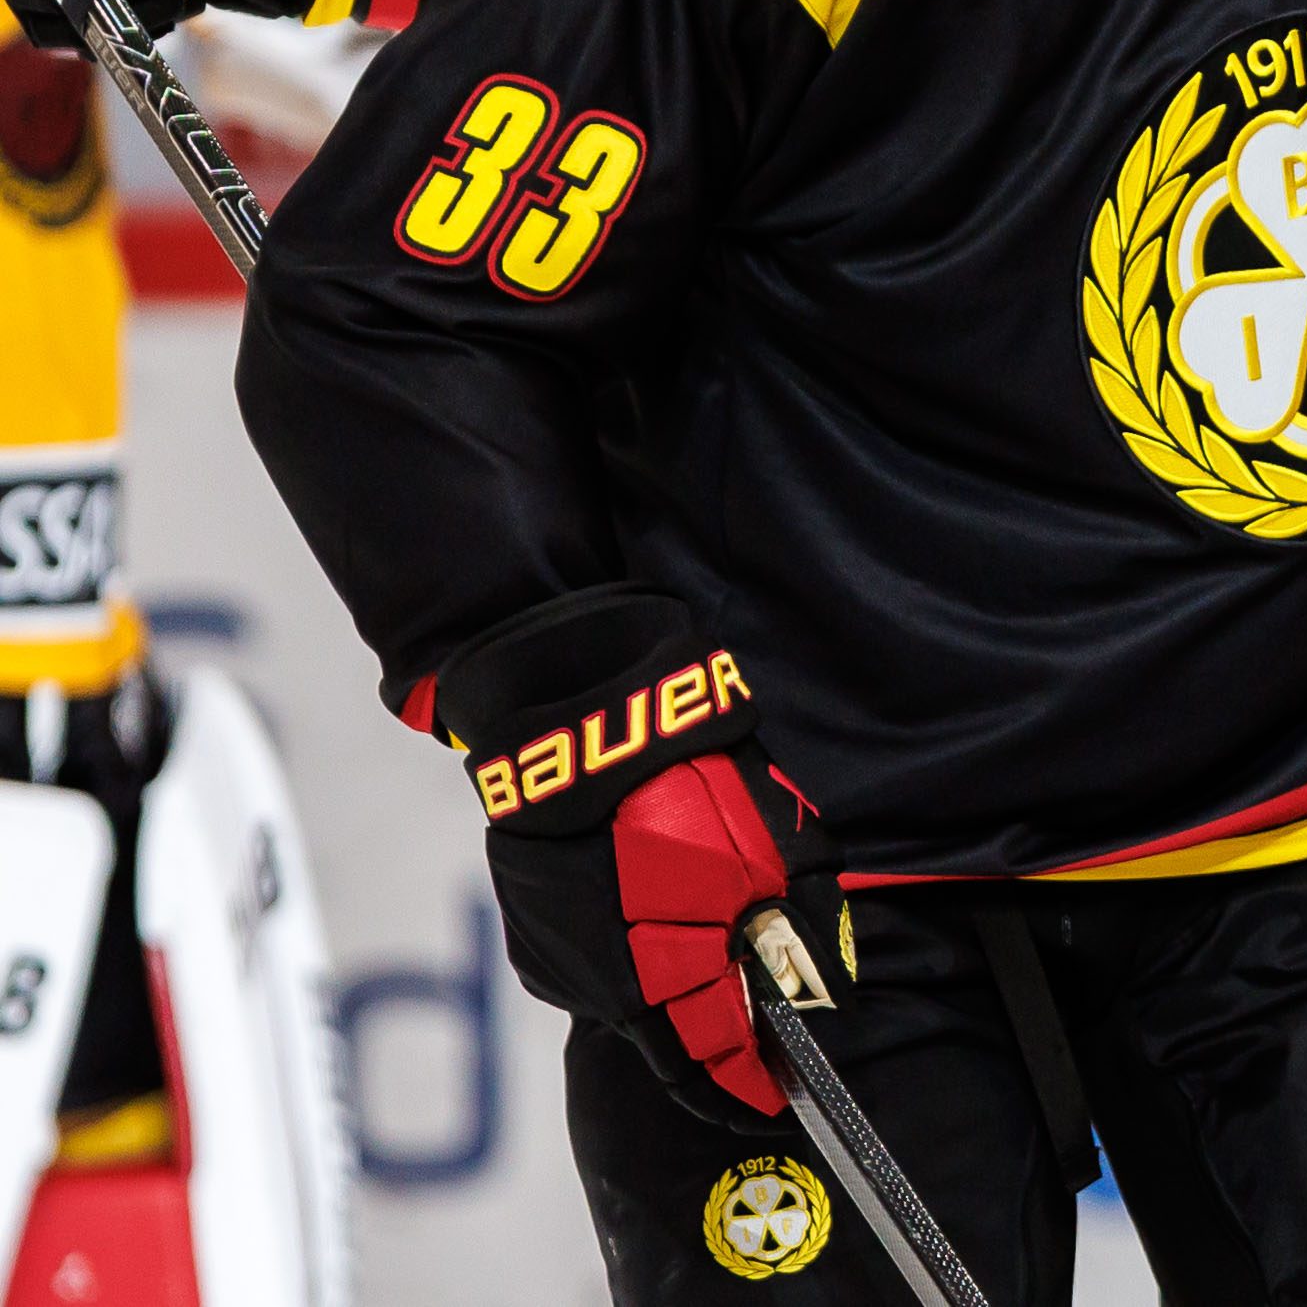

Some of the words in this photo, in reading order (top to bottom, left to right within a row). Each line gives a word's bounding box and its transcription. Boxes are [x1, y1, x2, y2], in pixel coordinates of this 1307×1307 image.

[394, 73, 648, 301] 33
[476, 649, 752, 821] BAUER
[737, 1156, 776, 1177] 1912
